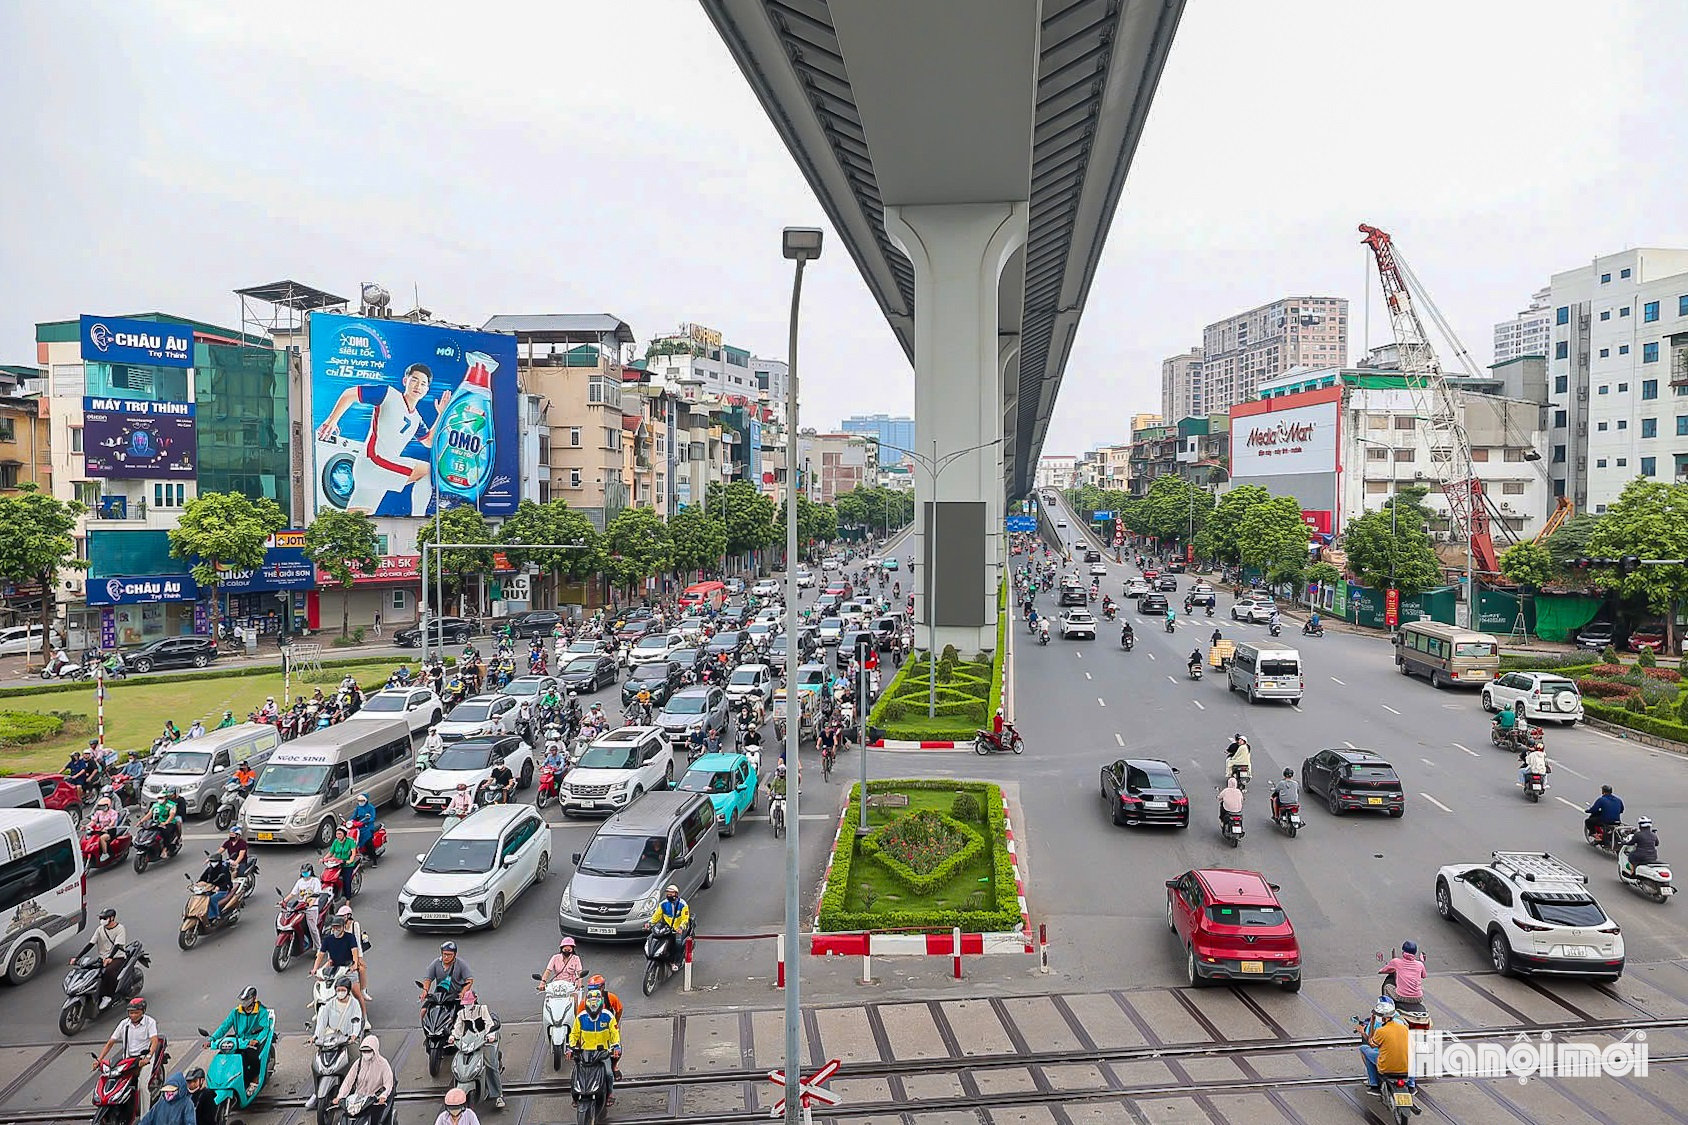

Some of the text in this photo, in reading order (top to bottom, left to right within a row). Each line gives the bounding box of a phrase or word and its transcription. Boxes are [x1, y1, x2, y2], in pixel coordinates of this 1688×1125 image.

[115, 333, 187, 351] CHÂU ÂU
[349, 336, 369, 347] OMO
[148, 350, 187, 359] Trợ Thính
[339, 347, 375, 357] siêu tốc
[436, 346, 454, 357] MỚI
[330, 357, 386, 369] Sạch Vượt Trội
[339, 365, 354, 377] 15
[92, 398, 188, 414] MÁY TRỢ THÍNH
[400, 417, 411, 433] 7
[1246, 422, 1314, 448] Media Mart
[448, 430, 480, 453] OMO
[454, 462, 465, 471] 15
[398, 559, 411, 568] 5K
[125, 581, 181, 594] CHÂU ÂU
[501, 590, 528, 600] QUY
